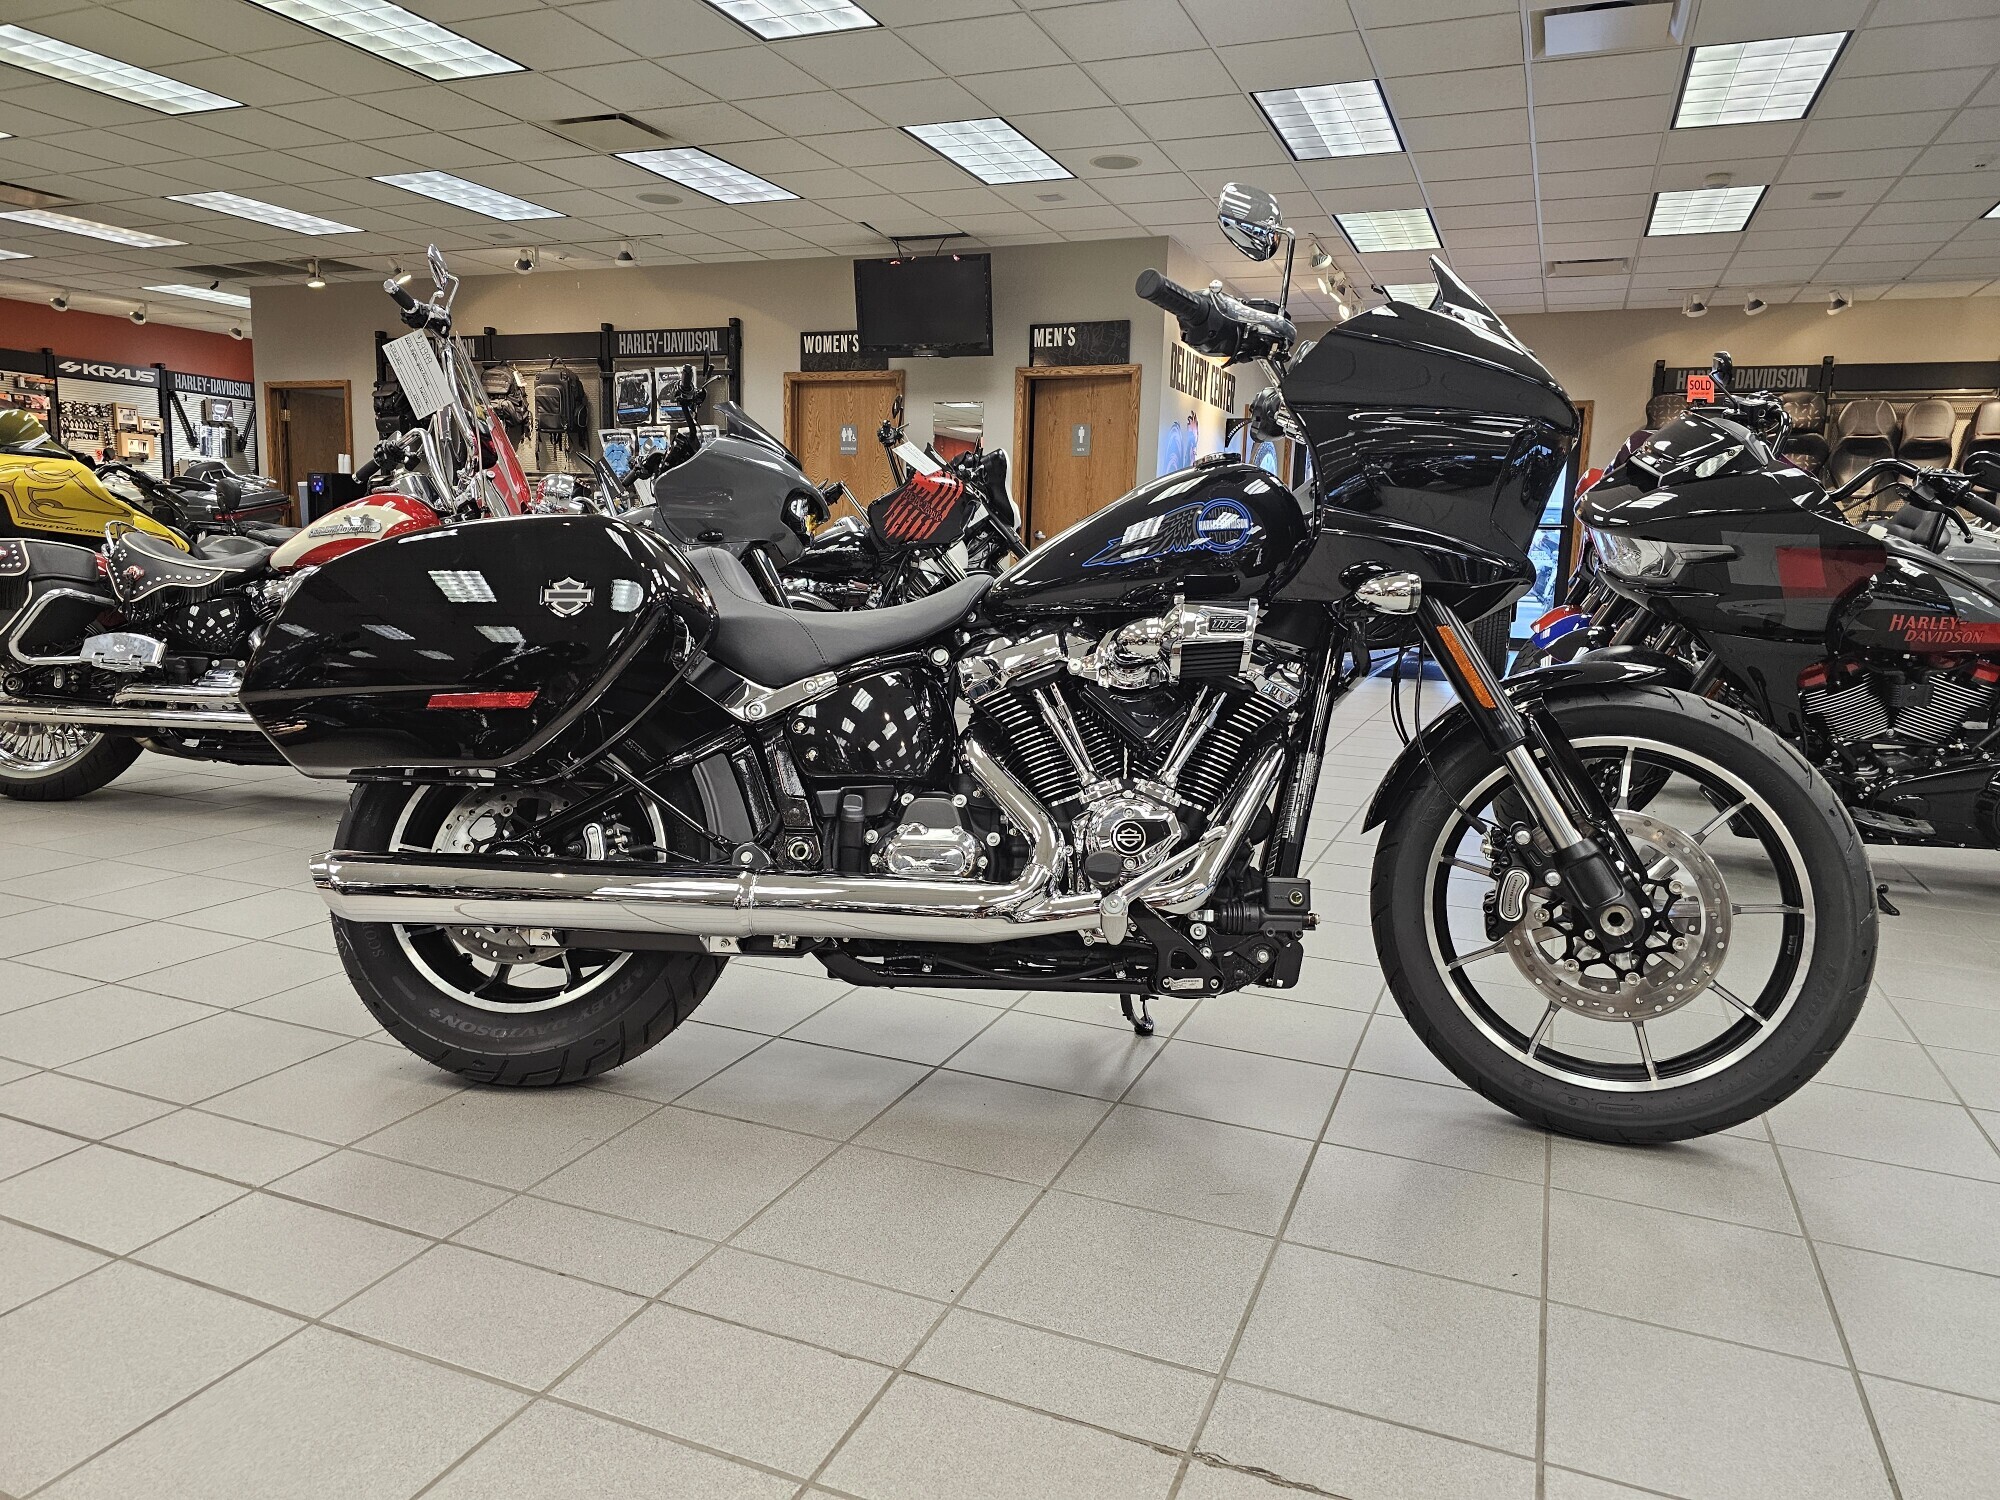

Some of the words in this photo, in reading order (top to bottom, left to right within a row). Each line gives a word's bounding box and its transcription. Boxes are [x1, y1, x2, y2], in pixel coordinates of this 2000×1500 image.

[619, 330, 718, 355] HARLEY-DAVIDSON
[803, 334, 860, 353] WOMEN'S
[1034, 326, 1076, 347] MEN'S
[83, 363, 156, 383] KRAUS
[1169, 341, 1210, 402] DELIVERY
[1210, 364, 1236, 414] CENTER
[175, 373, 251, 398] HARLEY-DAVIDSON
[1689, 380, 1712, 391] SOLD
[1889, 614, 1967, 632] HARLEY-
[1904, 630, 1983, 644] DAVIDSON
